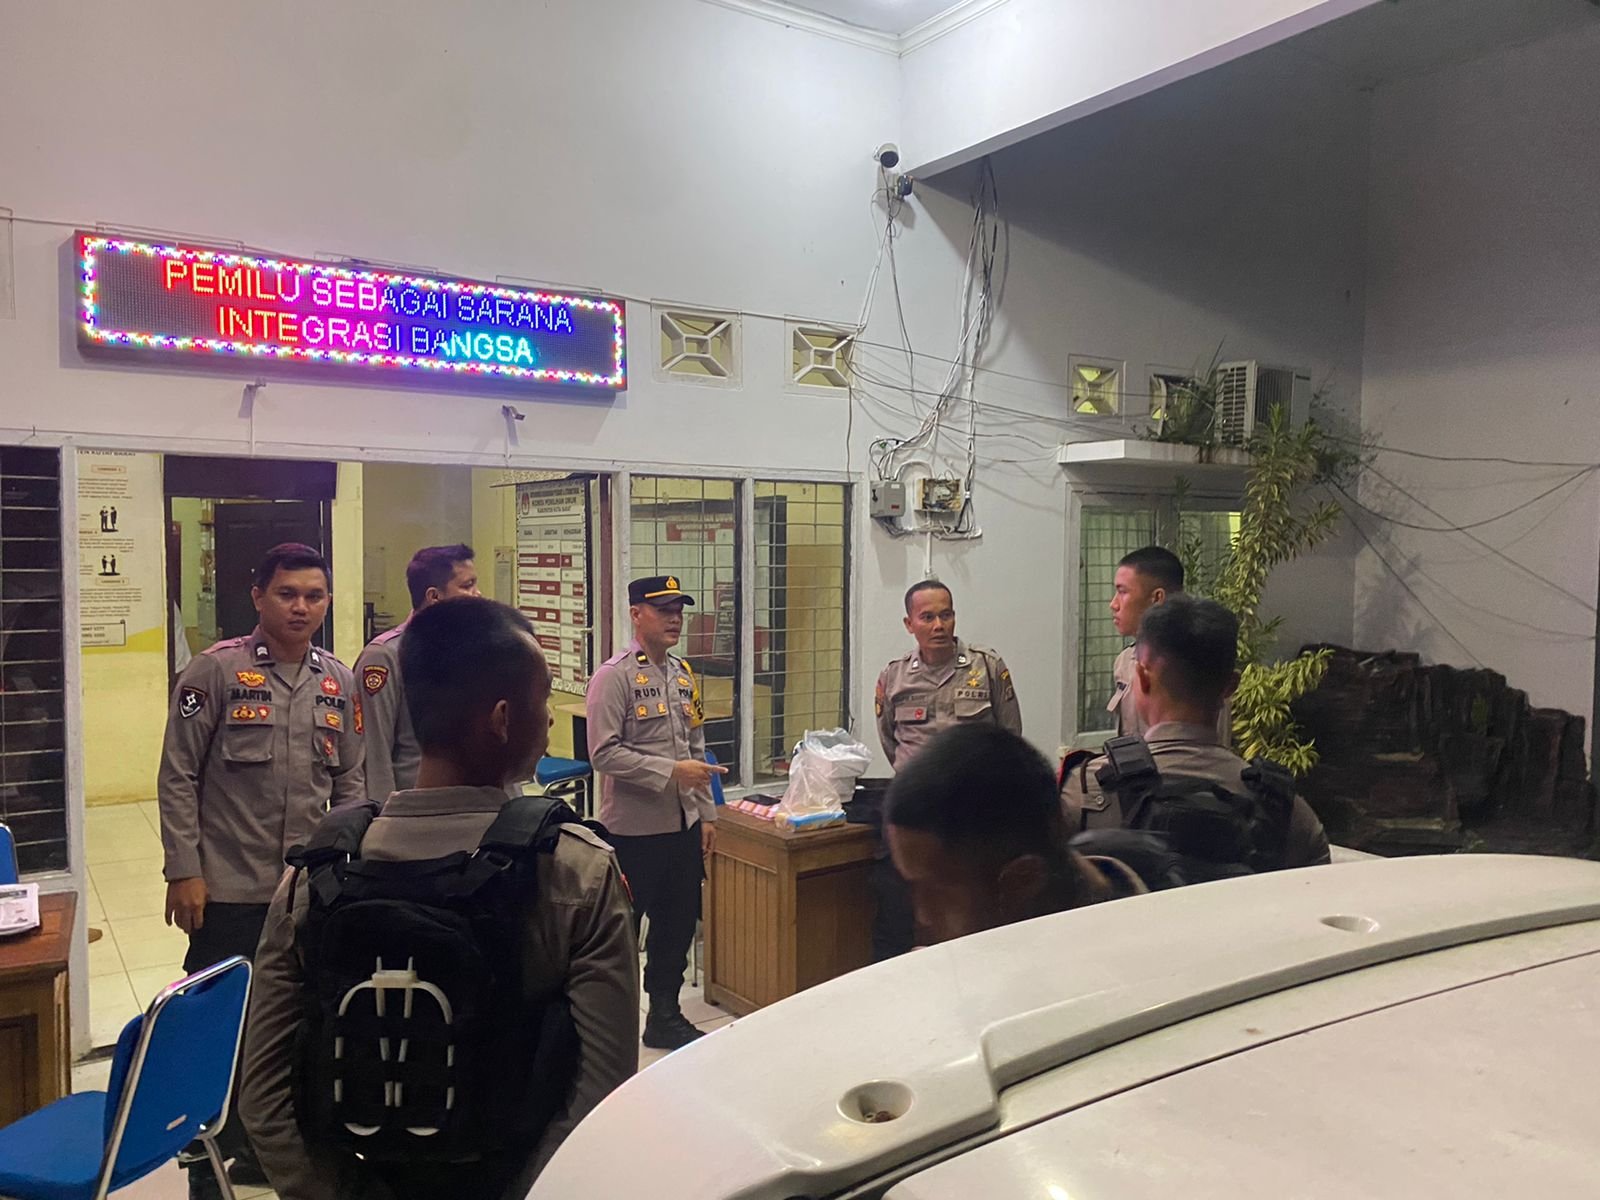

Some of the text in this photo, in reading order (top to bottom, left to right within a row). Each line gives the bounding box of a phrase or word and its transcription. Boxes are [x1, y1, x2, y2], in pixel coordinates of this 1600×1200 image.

[165, 258, 572, 334] PEMILU SEBAGAI SARANA
[218, 305, 533, 364] INTEGRASI BANGSA
[230, 688, 273, 702] MARTIN
[634, 687, 661, 700] RUDI
[957, 690, 988, 699] POLRI
